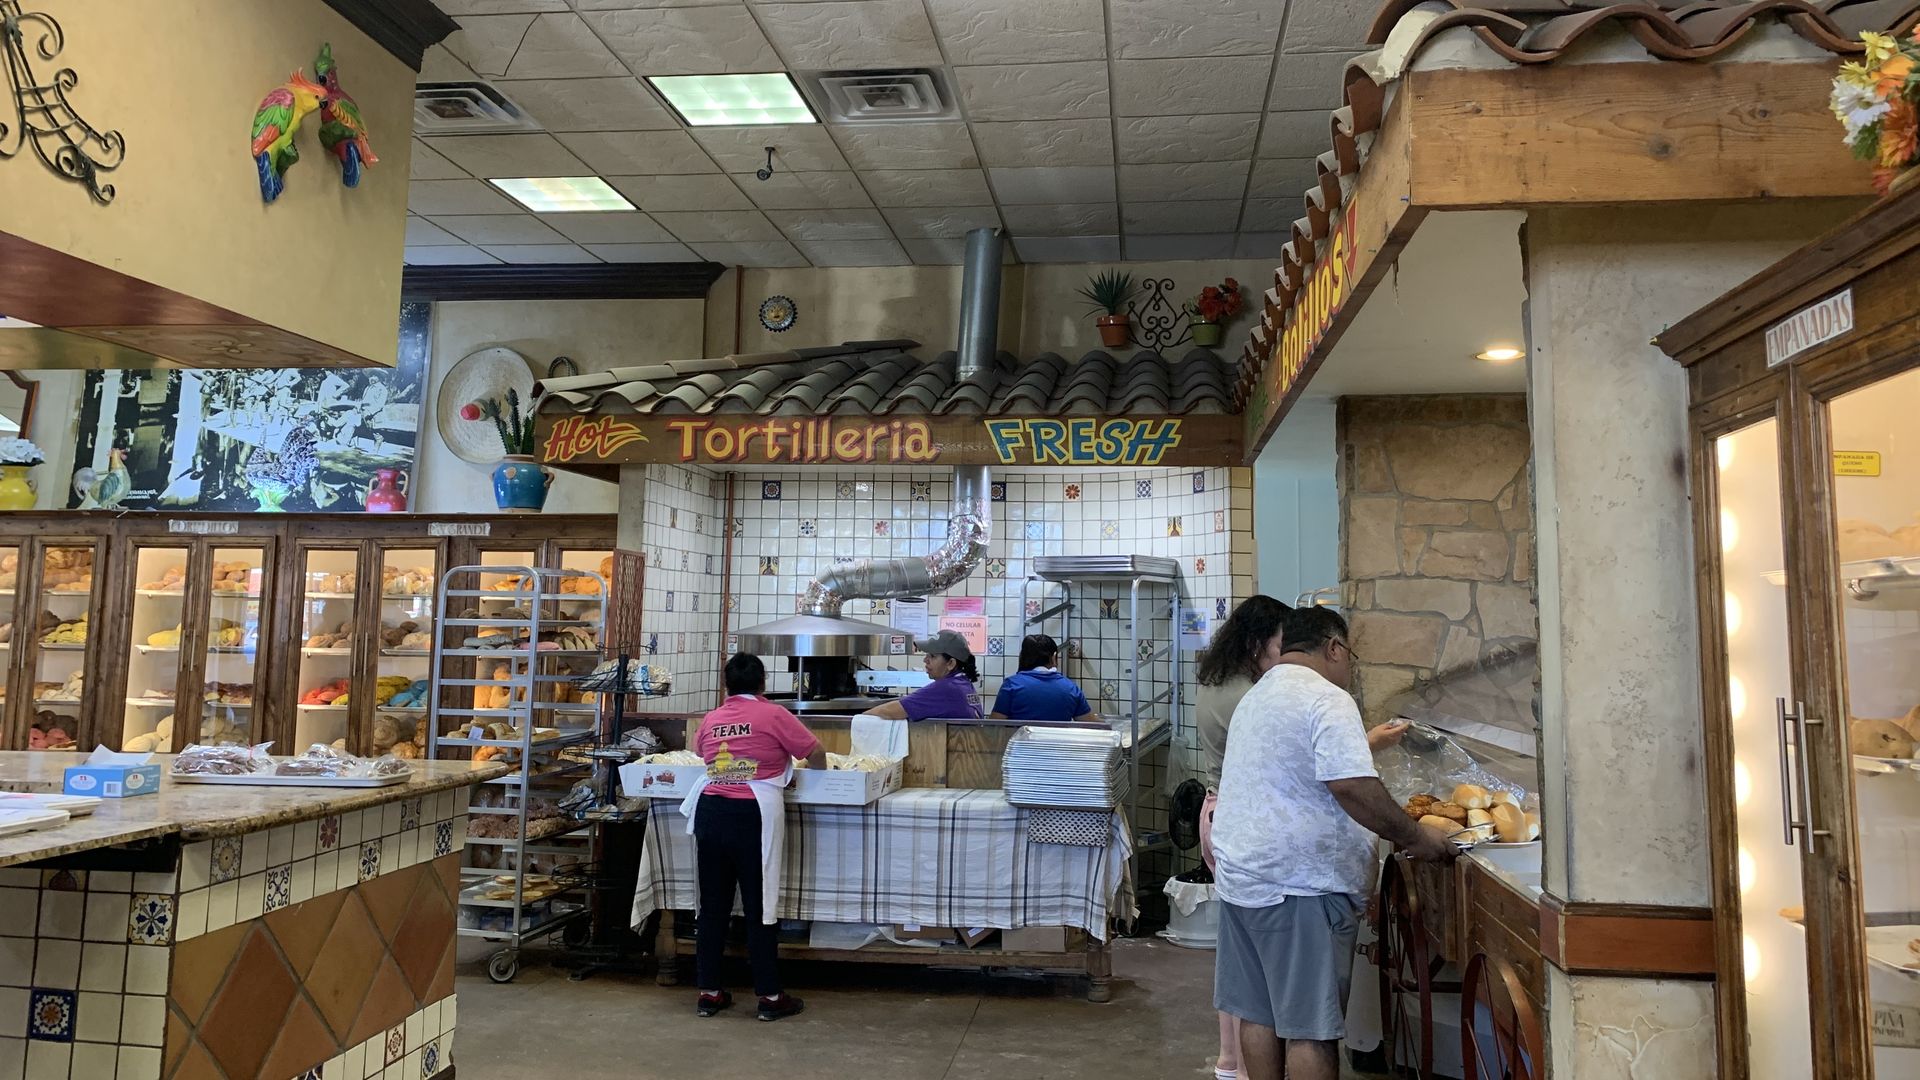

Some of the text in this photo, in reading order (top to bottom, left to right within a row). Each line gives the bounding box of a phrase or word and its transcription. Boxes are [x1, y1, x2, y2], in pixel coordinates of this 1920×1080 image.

[1767, 293, 1850, 364] EMPANADAS
[543, 415, 650, 463] Hot
[666, 418, 941, 464] Tortilleria
[984, 418, 1182, 465] FRESH
[712, 723, 752, 738] TEAM
[1874, 1008, 1905, 1028] PIÑA
